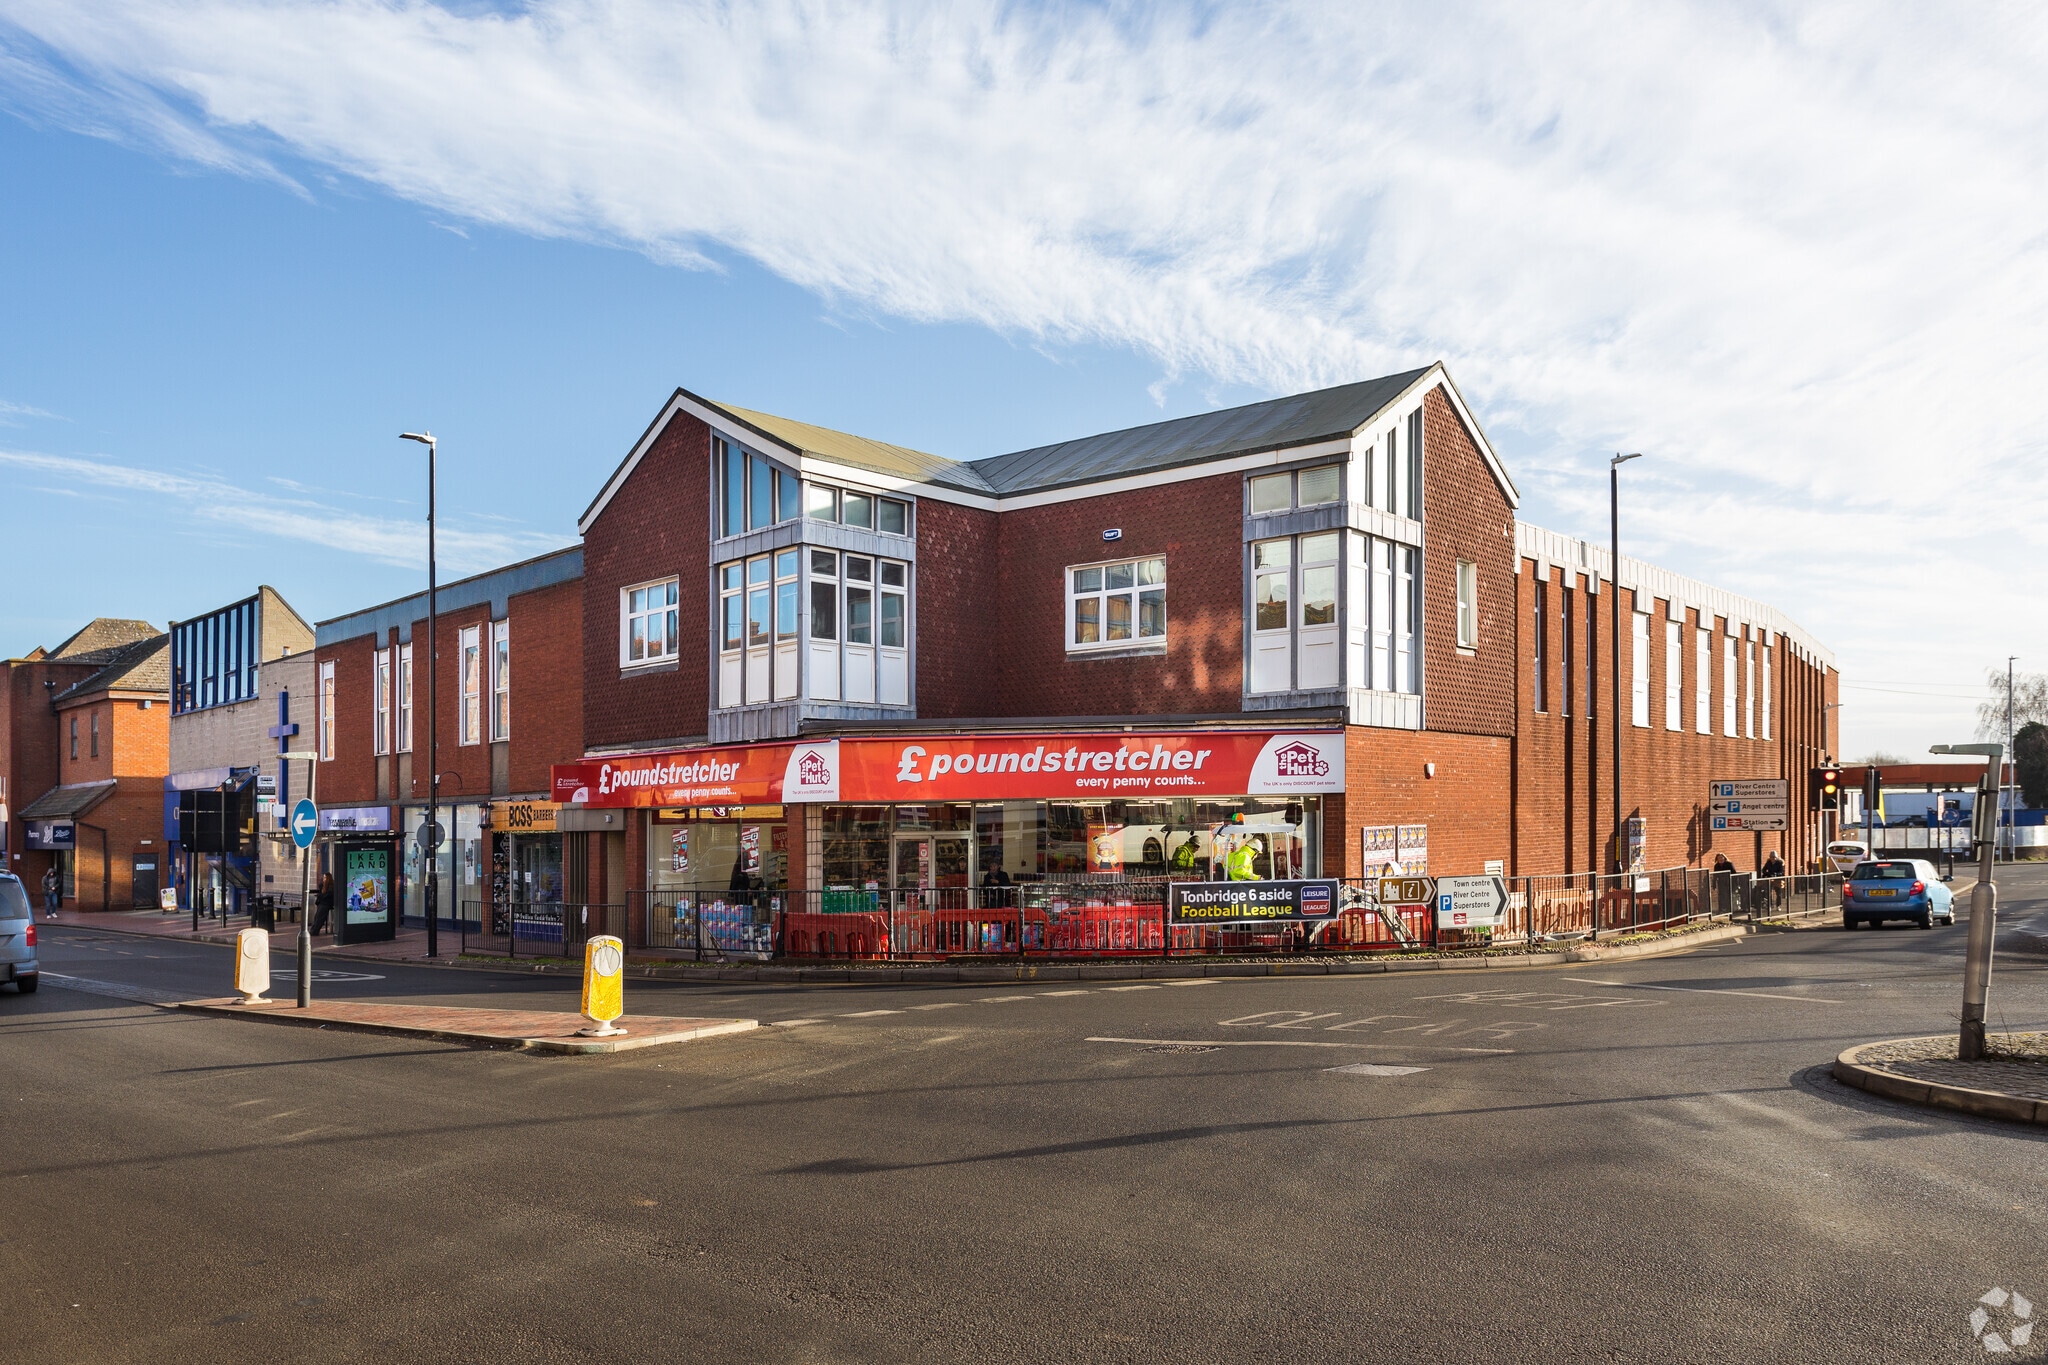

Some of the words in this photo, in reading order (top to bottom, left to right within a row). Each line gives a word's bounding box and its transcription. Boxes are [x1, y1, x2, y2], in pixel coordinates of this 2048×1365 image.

[1279, 753, 1287, 770] the
[1287, 751, 1314, 763] Pet
[805, 760, 822, 772] Pet
[1287, 762, 1314, 775] Hut
[805, 771, 822, 784] Hut
[1075, 777, 1109, 789] every
[1113, 776, 1151, 789] penny
[1154, 774, 1206, 786] counts...
[674, 788, 691, 800] every
[691, 788, 710, 799] penny
[1723, 785, 1732, 795] P
[1730, 802, 1739, 812] P
[508, 804, 533, 828] BOSS
[1716, 818, 1725, 828] P
[349, 852, 386, 861] IKEA
[349, 860, 386, 870] LAND
[1453, 880, 1469, 888] Town
[1471, 879, 1491, 887] centre
[1180, 889, 1247, 905] Tonbridge
[1248, 888, 1257, 901] 6
[1259, 888, 1293, 901] aside
[1303, 890, 1328, 898] LEISURE
[1453, 891, 1469, 899] River
[1470, 890, 1490, 898] Centre
[1303, 903, 1328, 911] LEAGUES
[1442, 896, 1451, 910] P
[1453, 901, 1490, 910] Superstores
[1181, 904, 1239, 918] Football
[1243, 903, 1293, 918] League
[1217, 1010, 1549, 1040] CLEAR
